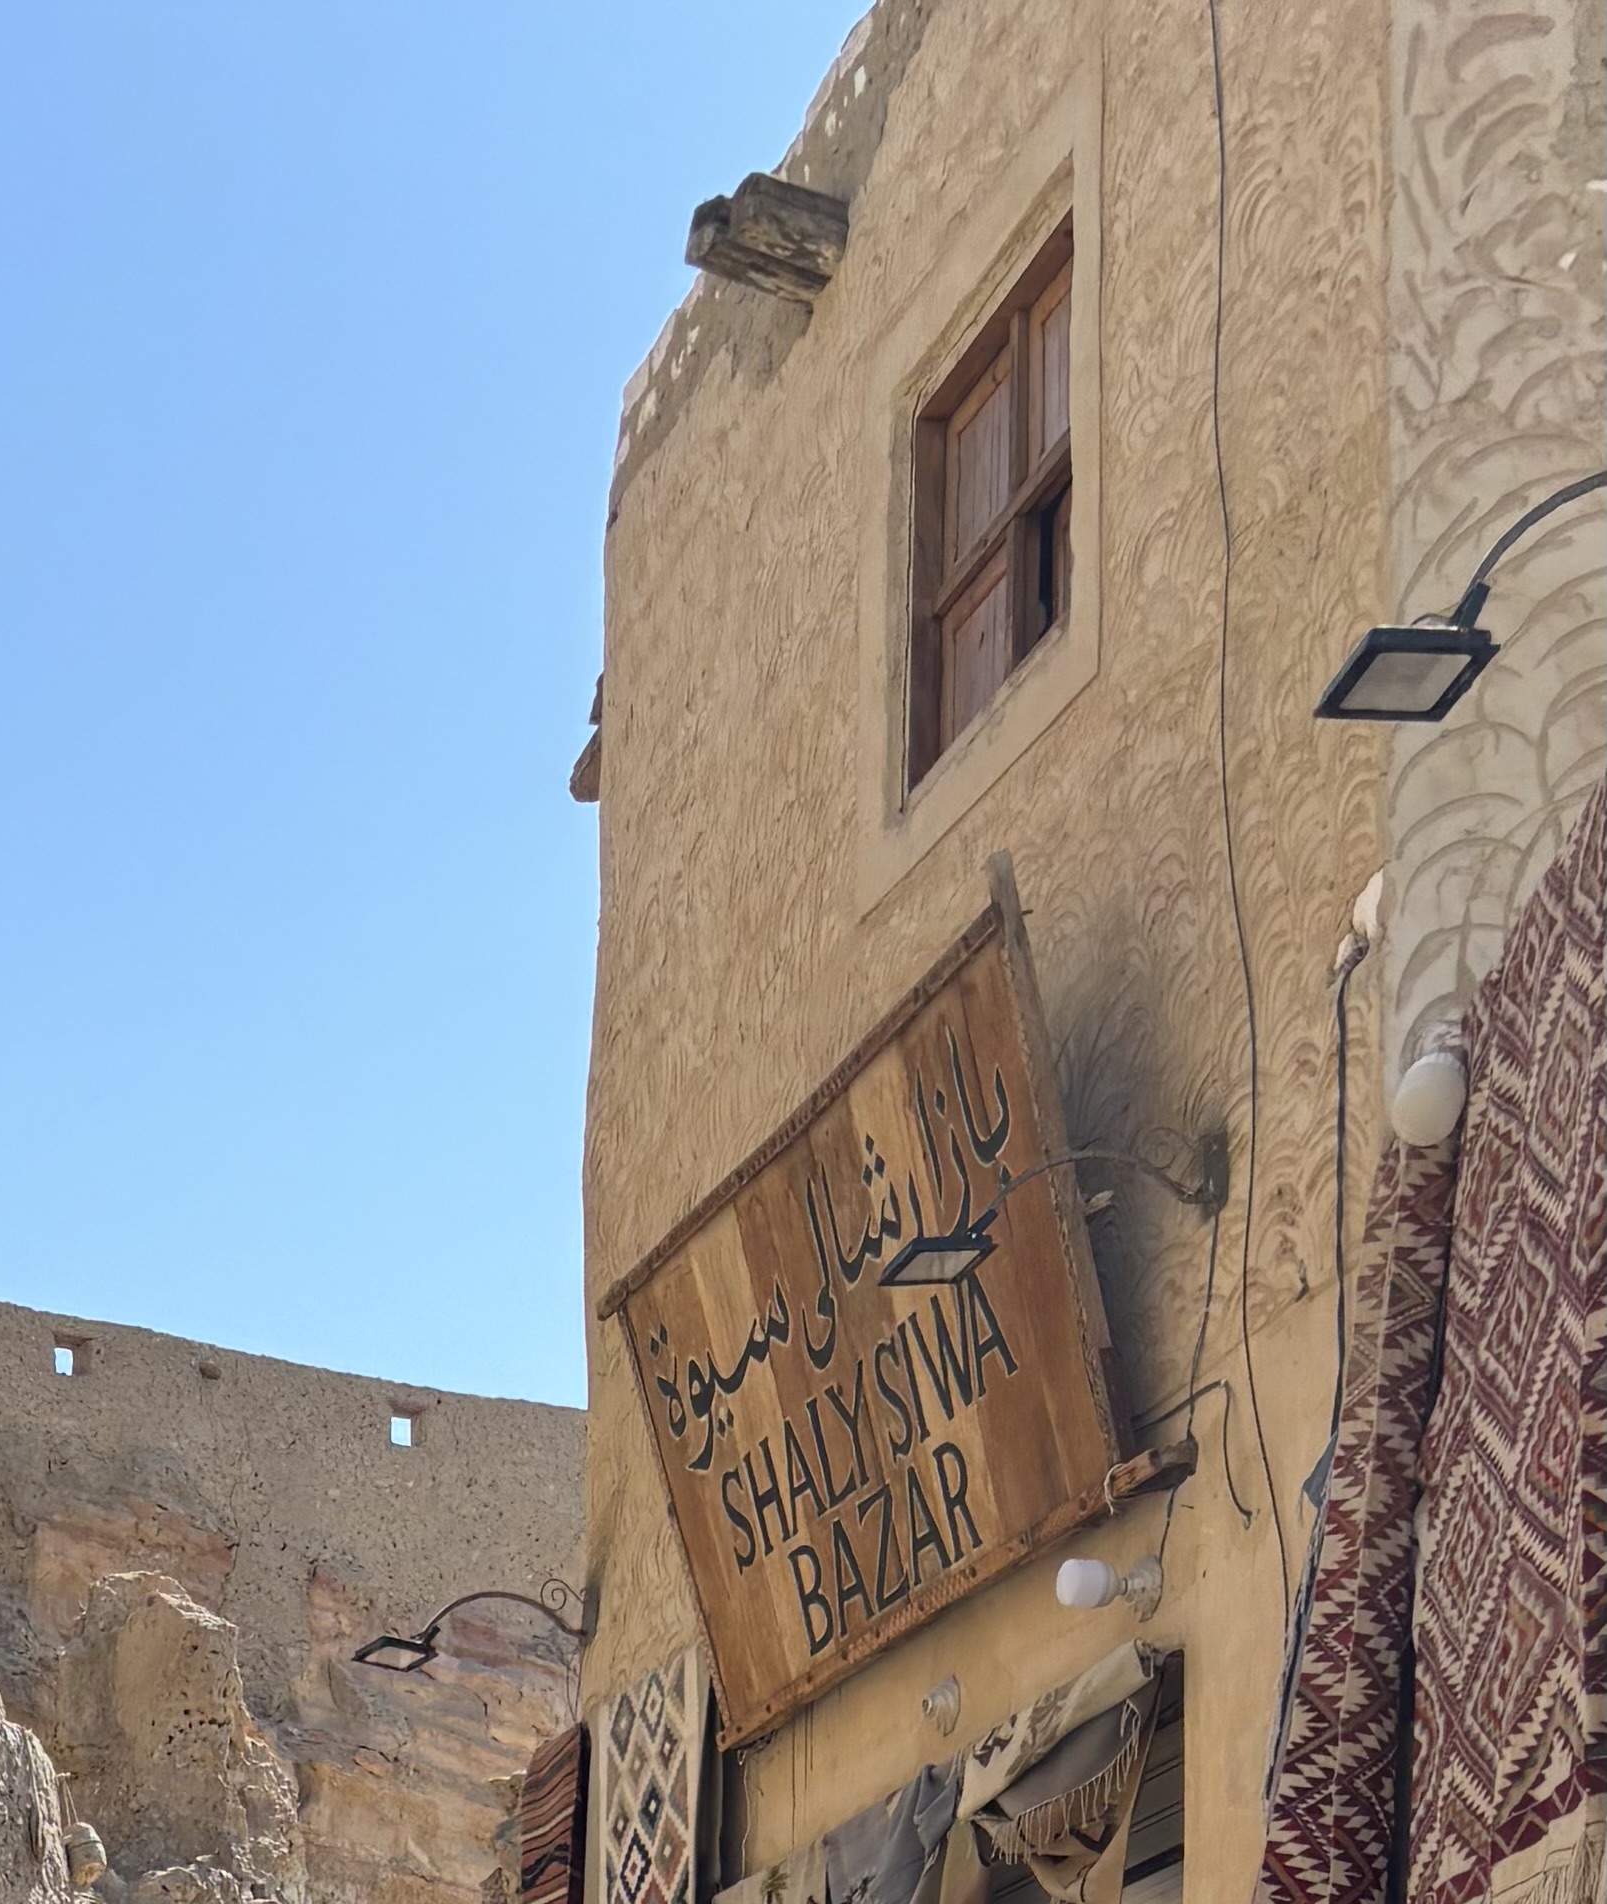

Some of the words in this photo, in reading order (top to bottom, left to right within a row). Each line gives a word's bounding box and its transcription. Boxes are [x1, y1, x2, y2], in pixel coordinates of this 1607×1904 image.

[721, 1358, 871, 1576] SHALY
[874, 1269, 1019, 1458] SIWA
[787, 1441, 984, 1657] BAZAR
